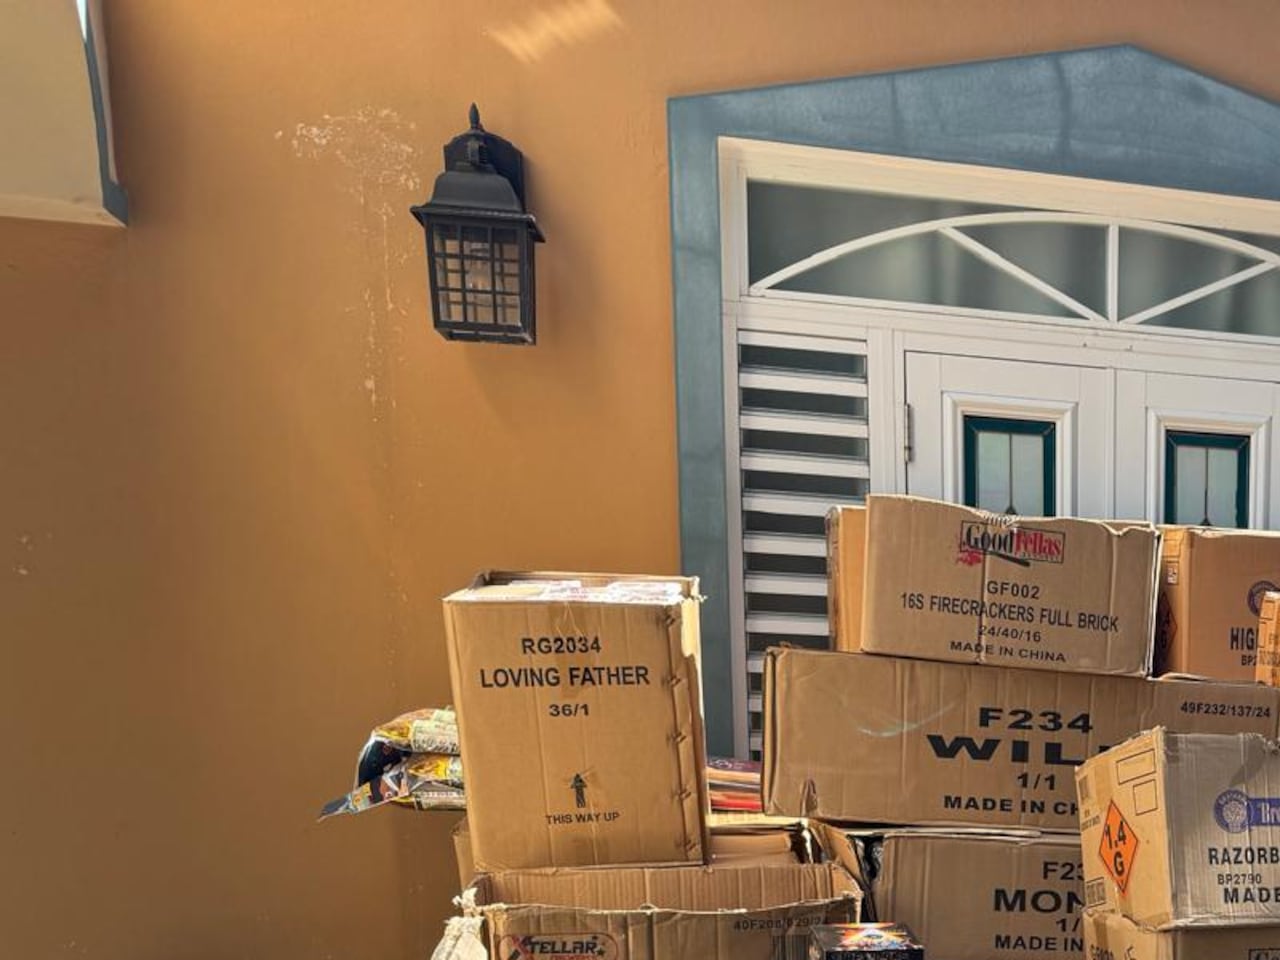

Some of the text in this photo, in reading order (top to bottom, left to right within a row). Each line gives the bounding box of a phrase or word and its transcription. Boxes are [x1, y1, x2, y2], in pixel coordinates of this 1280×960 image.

[987, 581, 1040, 600] GF002
[901, 592, 1119, 632] 16S FIRECRACKERS FULL BRICK
[978, 625, 1042, 643] 24/40/16
[521, 636, 602, 655] RG2034
[950, 641, 1066, 663] MADE IN CHINA
[480, 666, 650, 689] LOVING FATHER
[549, 703, 590, 717] 36/1
[1180, 701, 1271, 718] 49F232/137/24
[979, 707, 1094, 734] F234
[1017, 773, 1056, 791] 1/1
[944, 796, 1046, 814] MADE IN
[546, 812, 620, 825] THIS WAY UP
[1218, 874, 1262, 885] BP2790
[995, 935, 1084, 951] MADE IN
